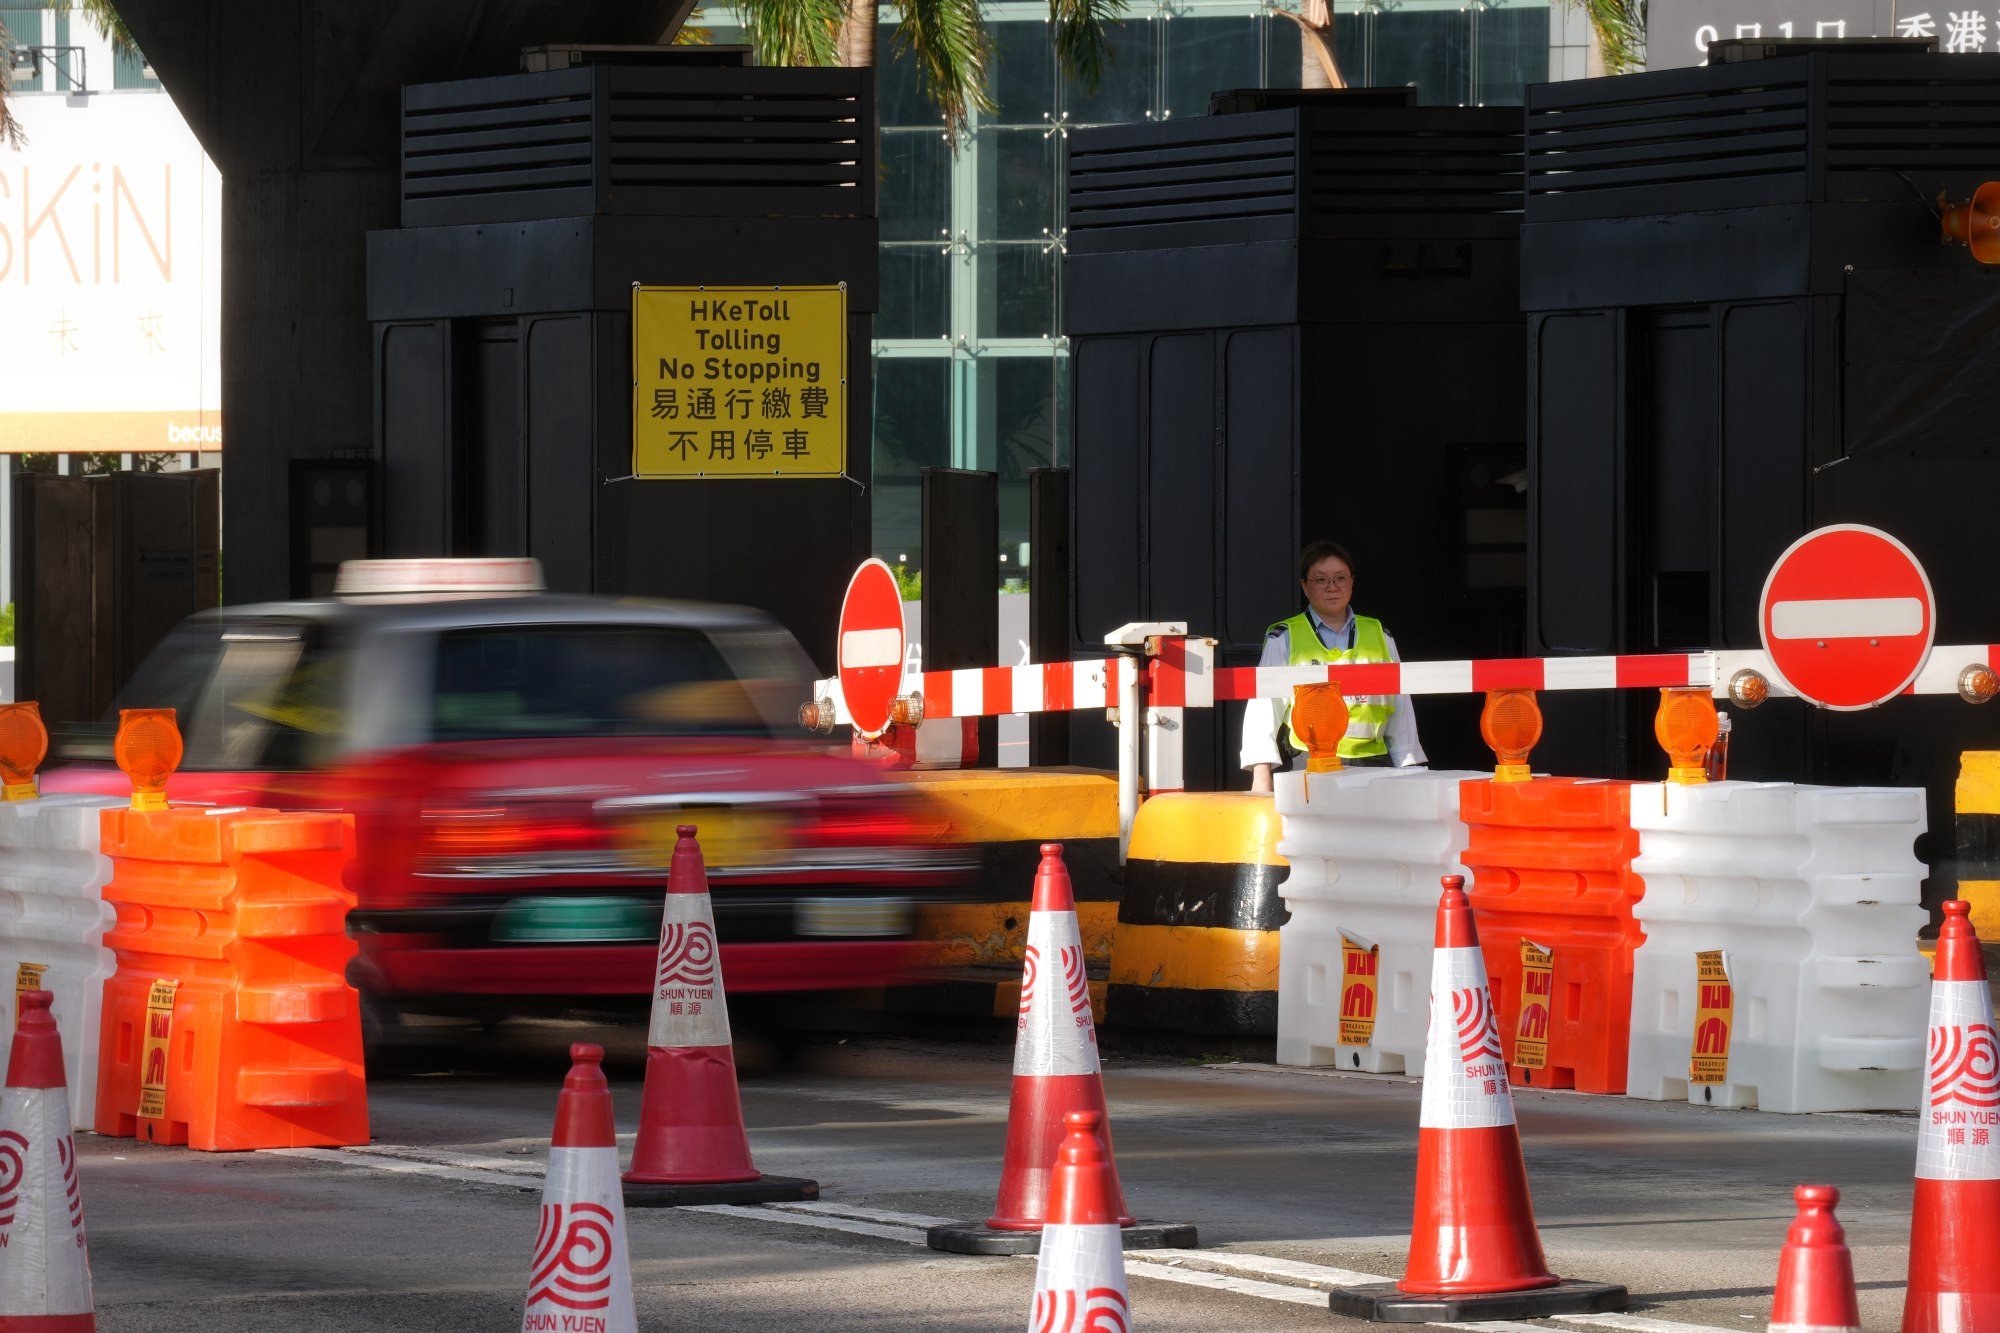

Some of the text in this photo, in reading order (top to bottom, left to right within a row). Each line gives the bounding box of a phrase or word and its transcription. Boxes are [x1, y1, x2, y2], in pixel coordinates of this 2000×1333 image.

[690, 300, 790, 322] HKeToll
[695, 328, 781, 355] Tolling
[659, 357, 820, 383] No Stopping
[650, 386, 829, 420] 易通行繳費
[667, 428, 811, 461] 不用停車
[660, 988, 713, 1000] SHUN YUEN
[669, 1001, 702, 1016] 順源
[1465, 1063, 1496, 1079] SHUN
[1932, 1111, 1966, 1125] SHUN
[1947, 1127, 1990, 1145] 順源
[525, 1313, 606, 1333] SHUN YUEN
